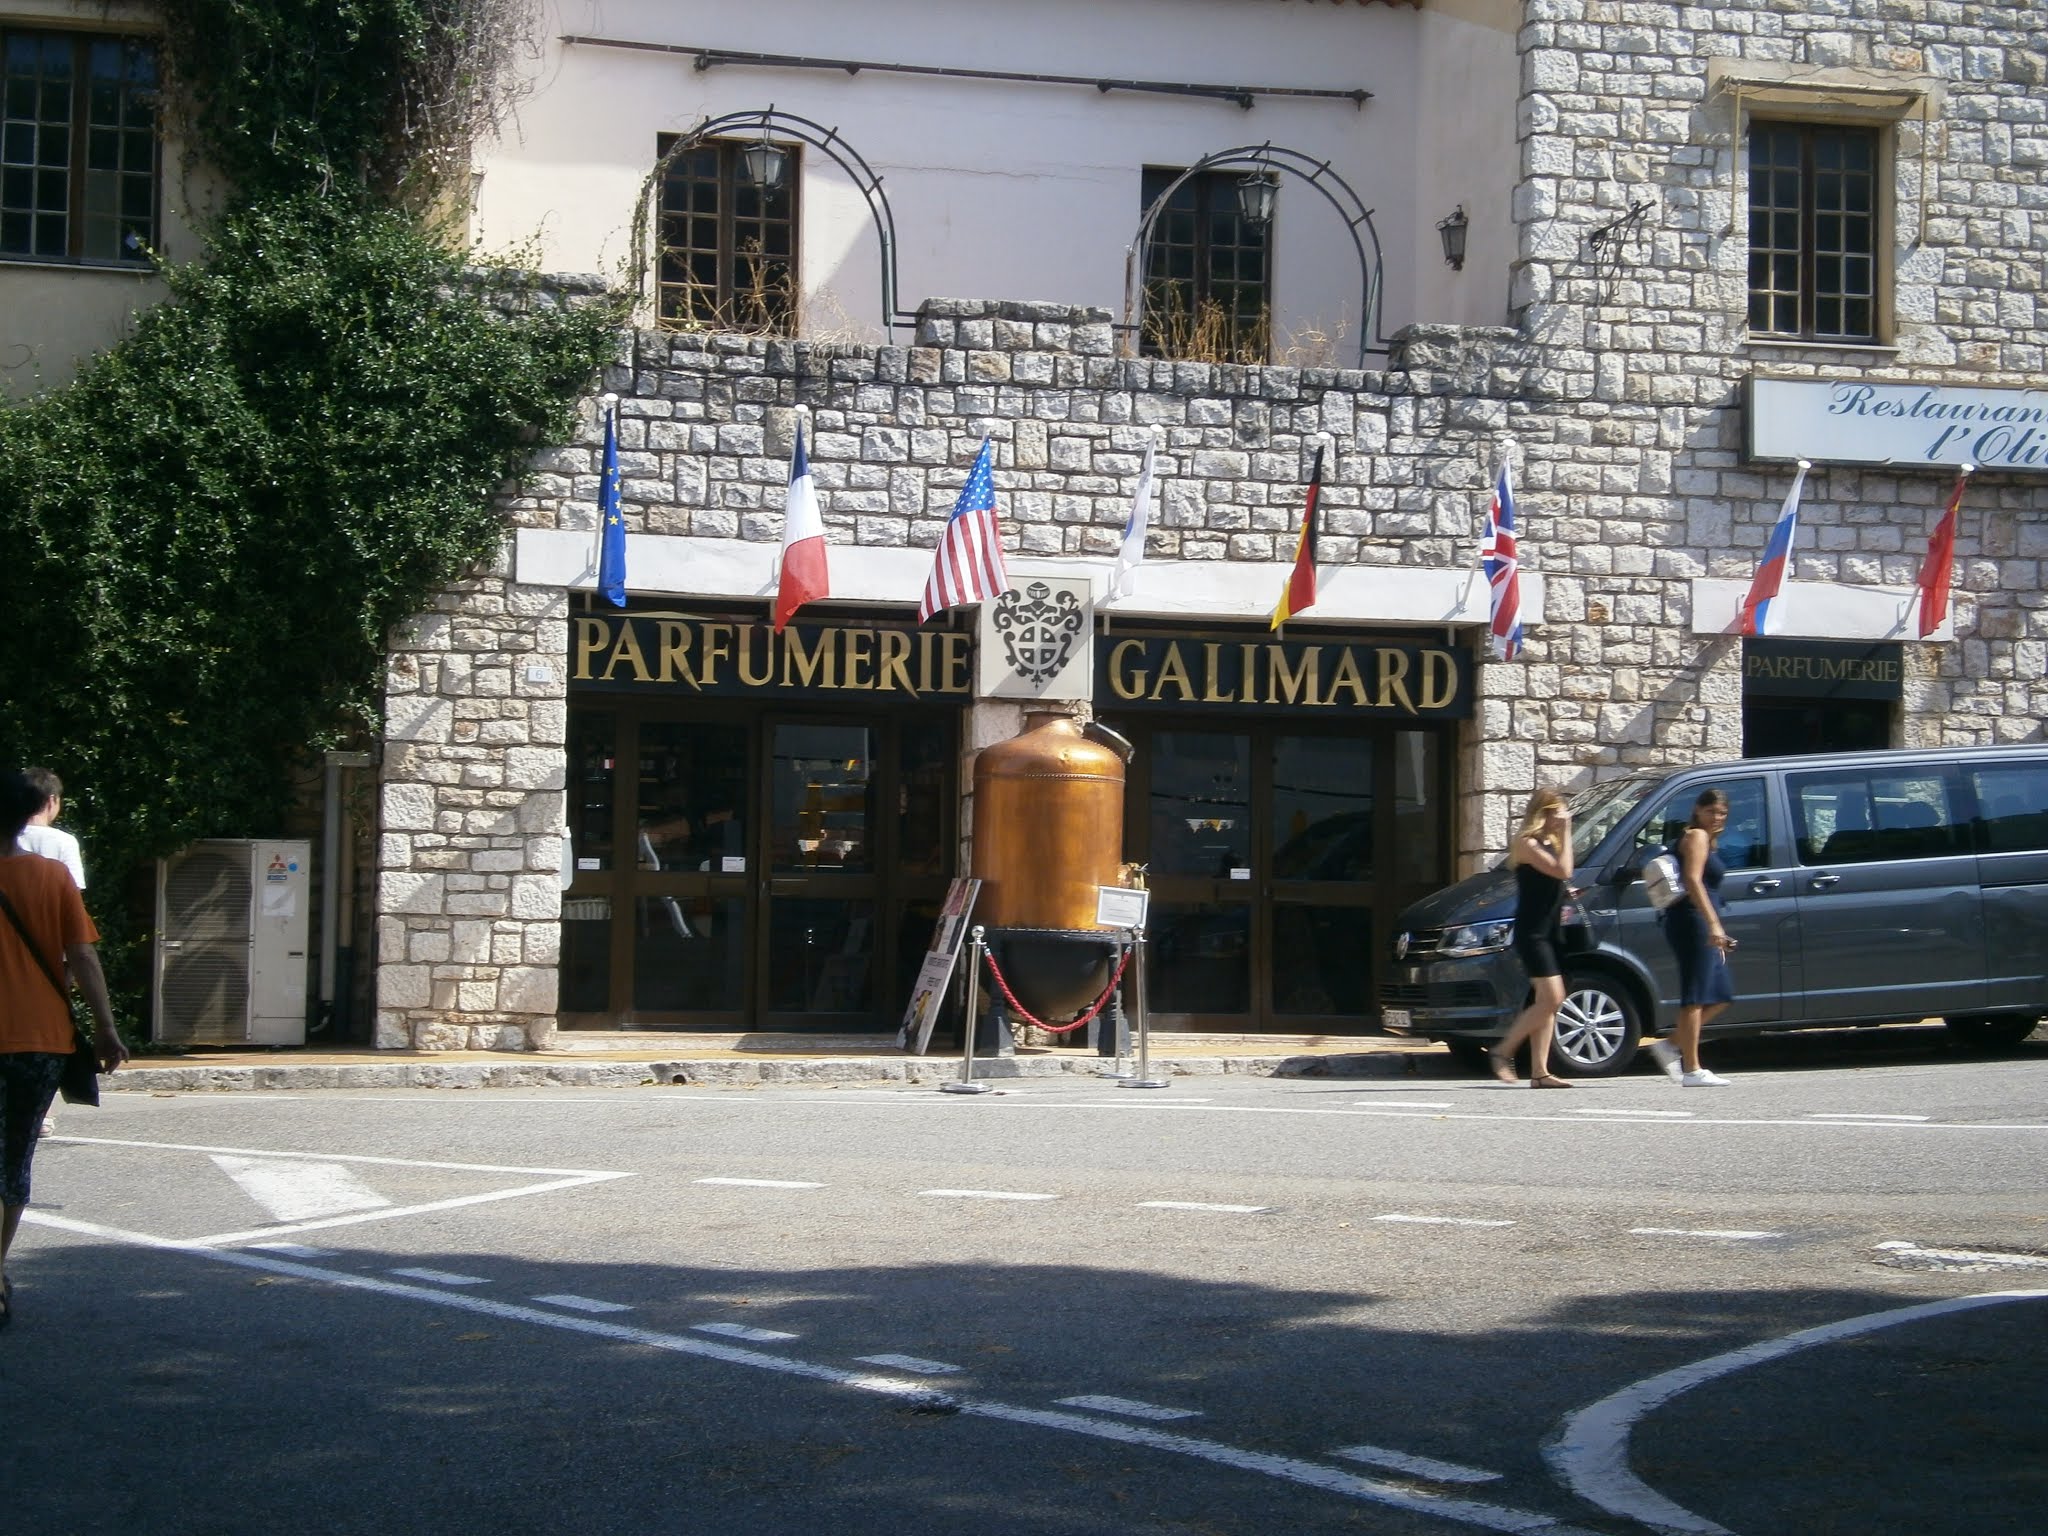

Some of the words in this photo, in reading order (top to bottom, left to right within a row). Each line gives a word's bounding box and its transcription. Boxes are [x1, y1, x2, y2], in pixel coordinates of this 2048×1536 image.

[1828, 383, 2048, 424] Restauran
[1923, 424, 2048, 464] l'Oli
[572, 617, 971, 699] PARFUMERIE
[1108, 639, 1459, 716] GALIMARD
[1745, 655, 1899, 682] PARFUMERIE
